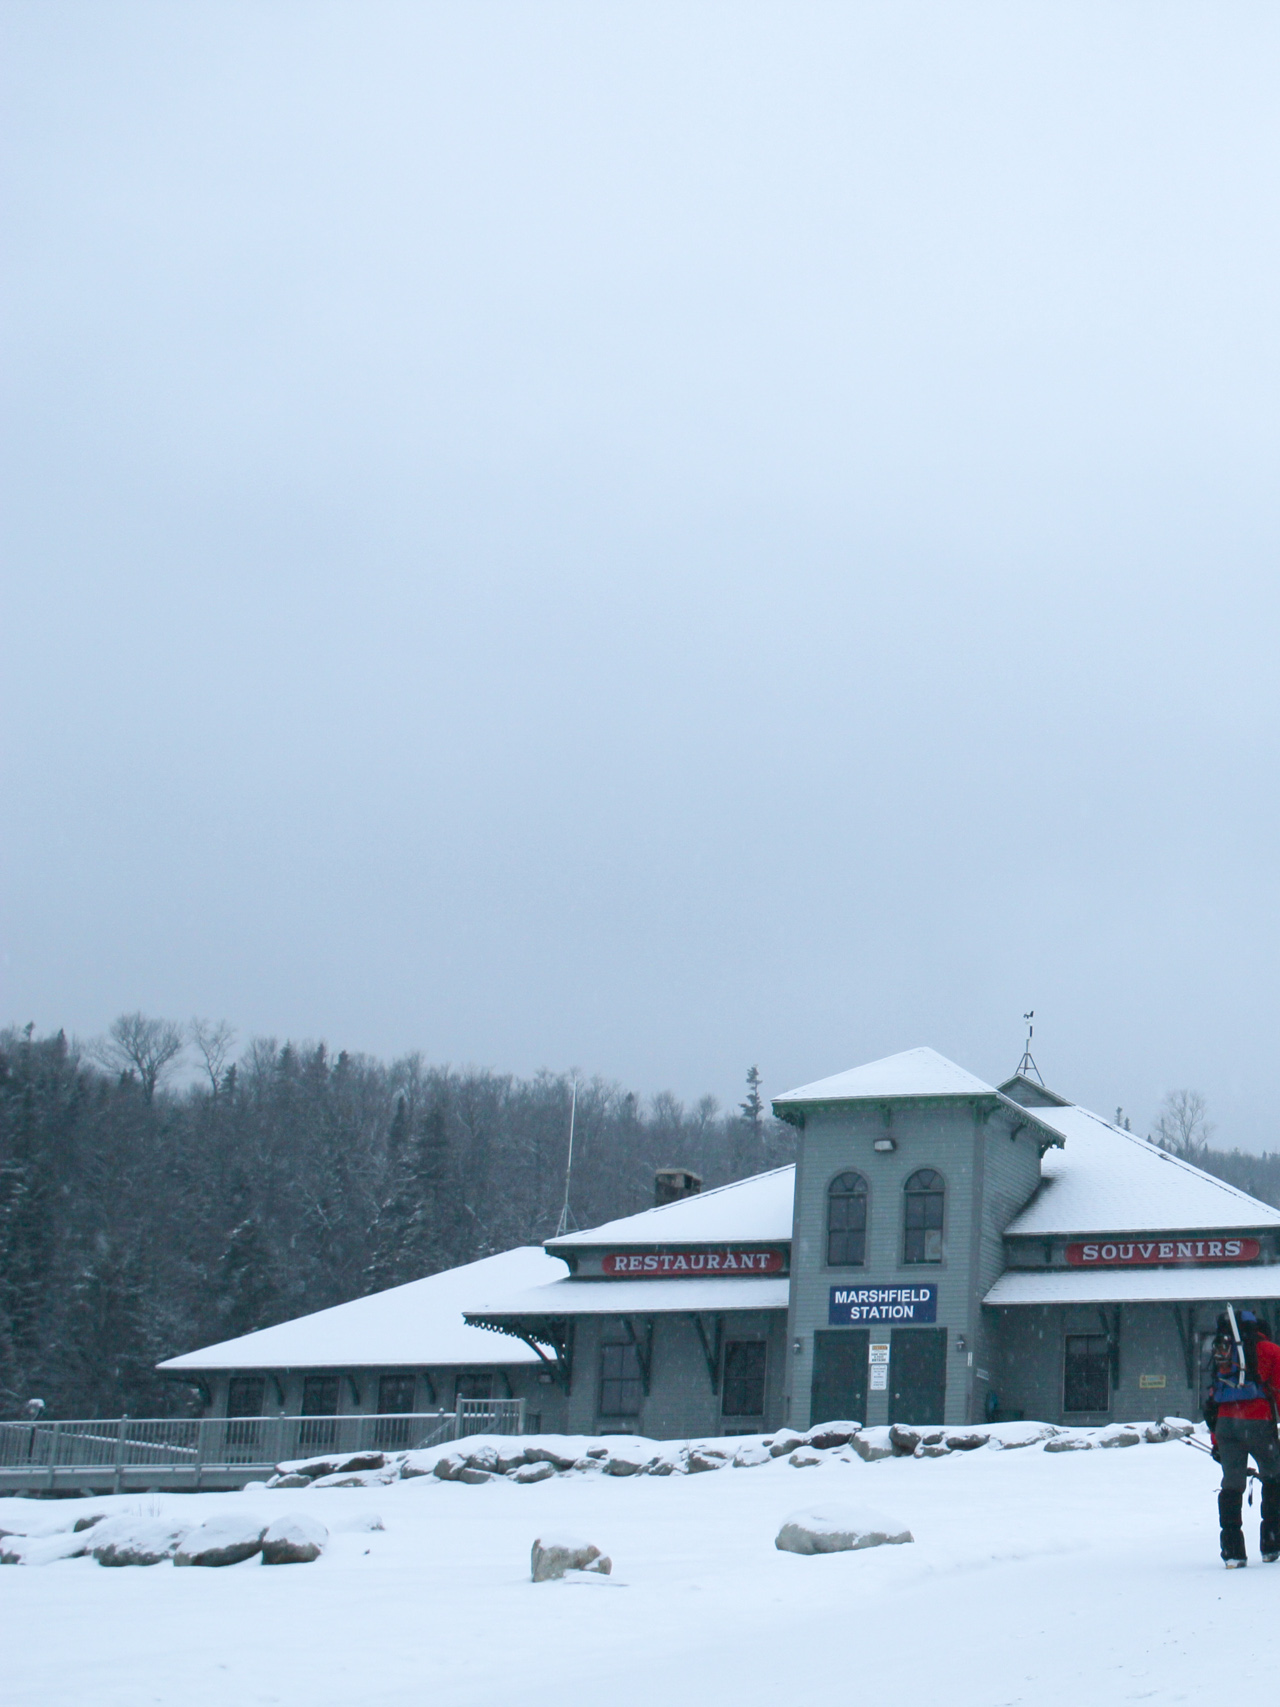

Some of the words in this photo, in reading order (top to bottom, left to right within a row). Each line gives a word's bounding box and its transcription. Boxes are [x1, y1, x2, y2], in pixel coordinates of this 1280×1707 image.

[1082, 1240, 1241, 1261] SOUVENIRS
[614, 1253, 770, 1271] RESTAURANT
[835, 1289, 930, 1304] MARSHFIELD
[850, 1305, 914, 1319] STATION
